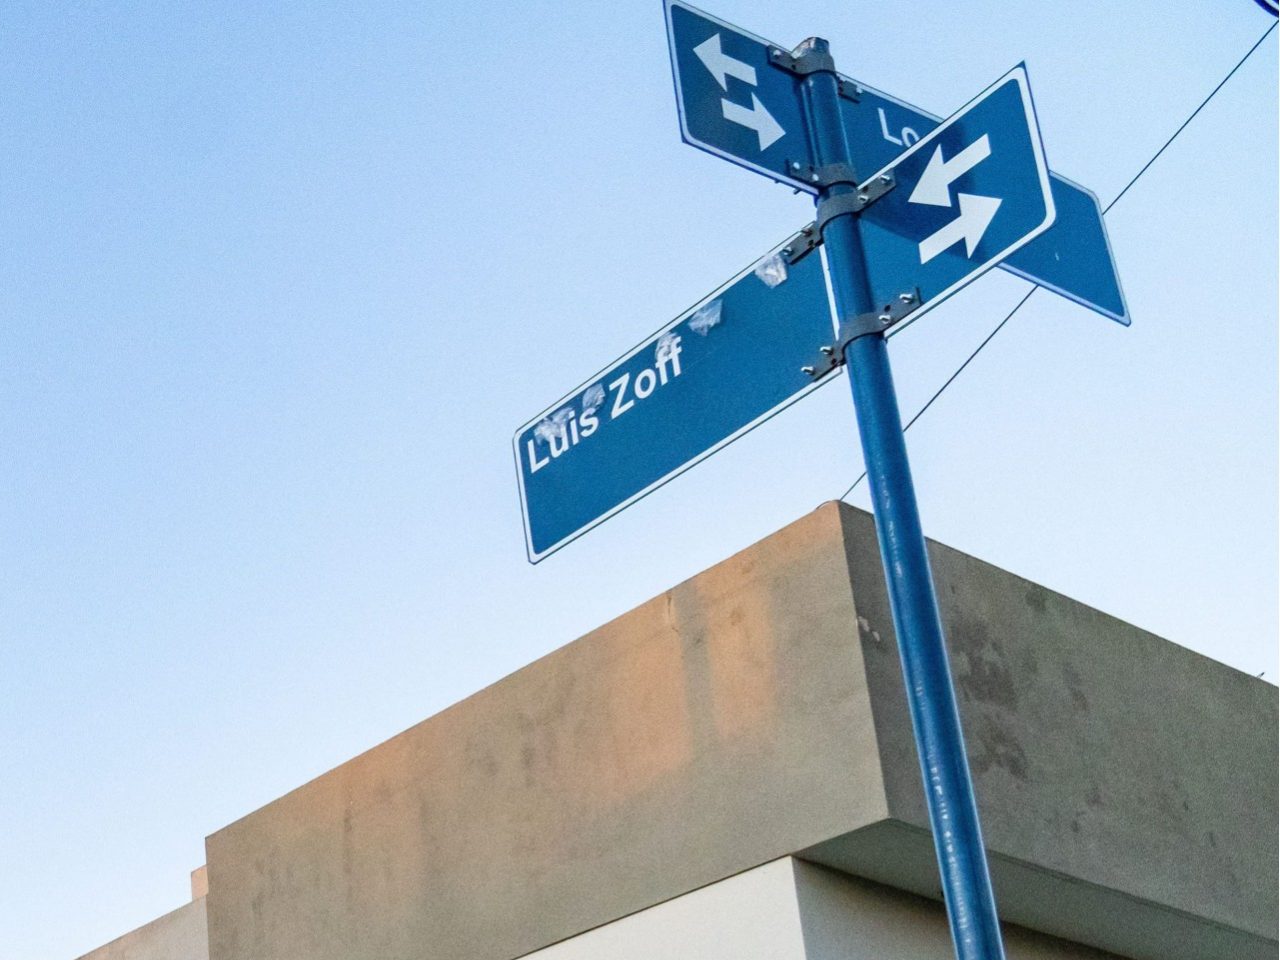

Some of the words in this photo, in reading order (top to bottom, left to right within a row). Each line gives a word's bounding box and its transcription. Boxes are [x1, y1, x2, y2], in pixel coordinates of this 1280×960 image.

[877, 107, 921, 148] Lo
[527, 407, 600, 474] Luis
[608, 335, 683, 420] Zoff
